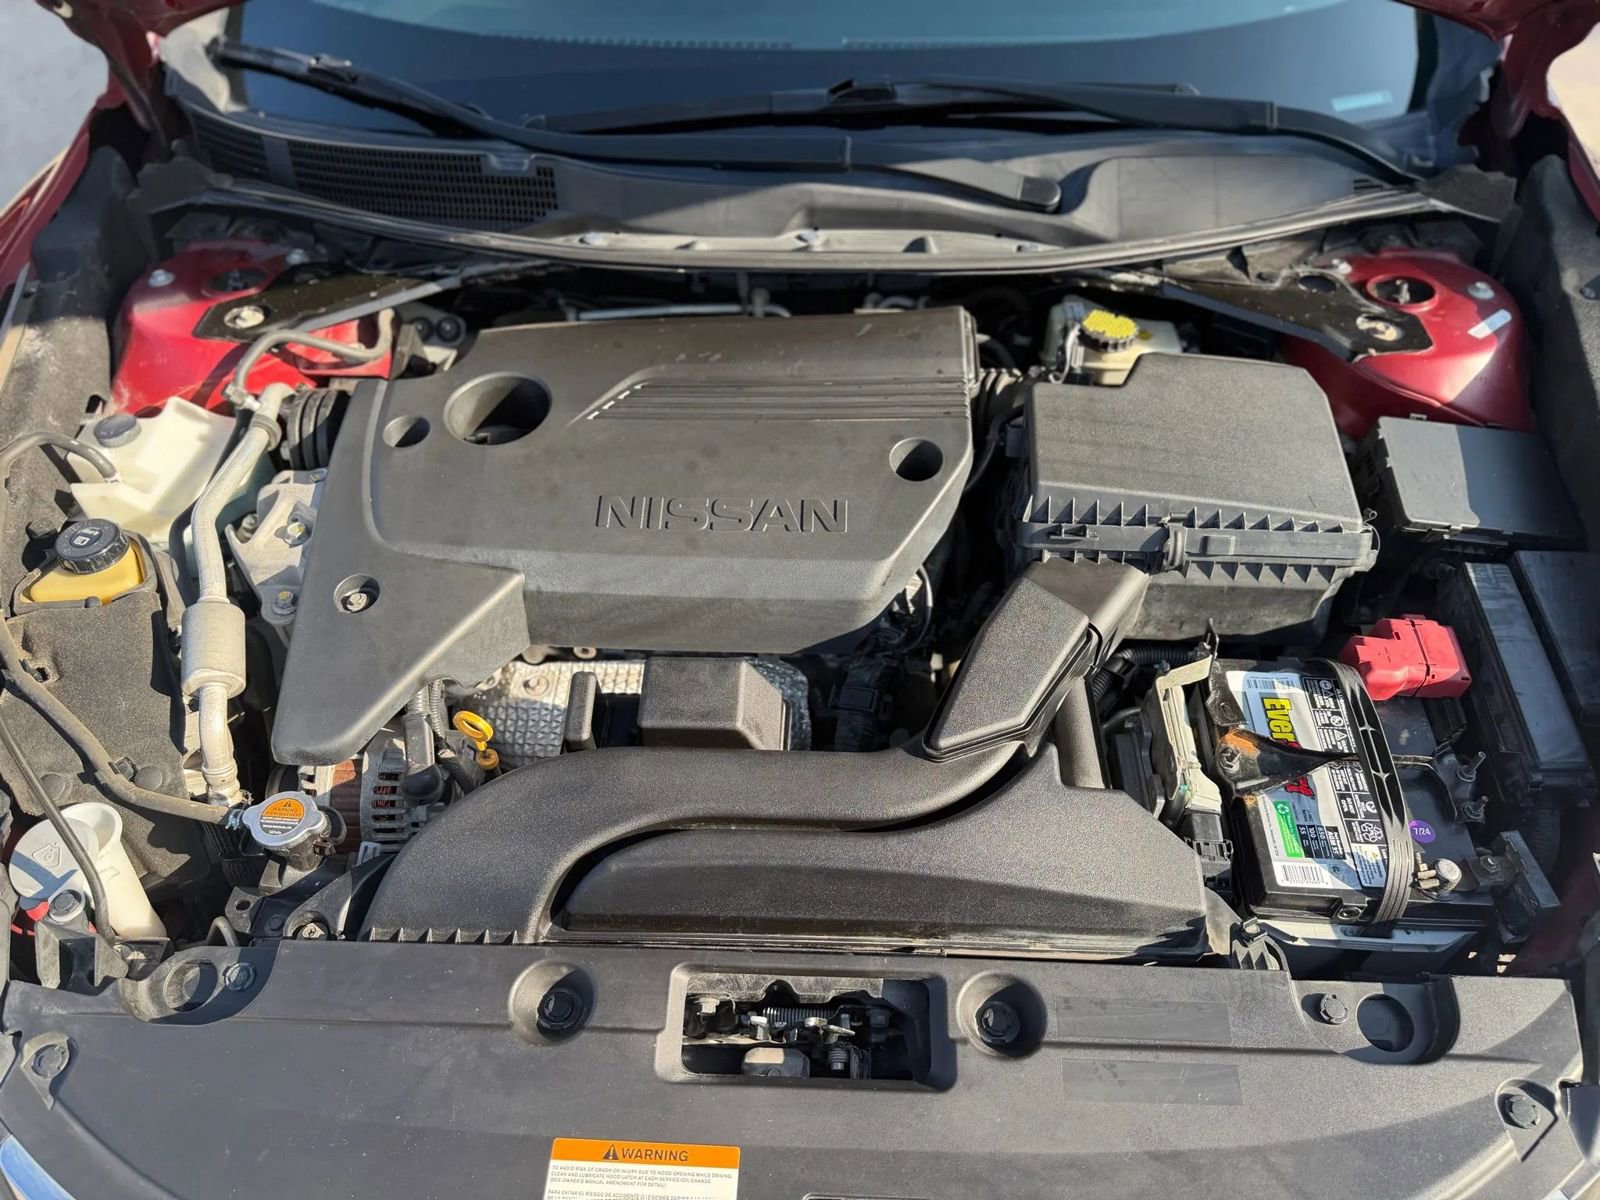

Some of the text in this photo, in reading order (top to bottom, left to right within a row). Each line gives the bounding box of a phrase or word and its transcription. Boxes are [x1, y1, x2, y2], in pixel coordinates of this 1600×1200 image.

[596, 496, 848, 533] NISSAN
[1298, 826, 1306, 834] 55
[1308, 826, 1317, 838] 100
[1316, 826, 1325, 839] 650
[1413, 827, 1431, 836] 7/24
[1326, 830, 1336, 845] AGM
[622, 1148, 688, 1161] WARNING
